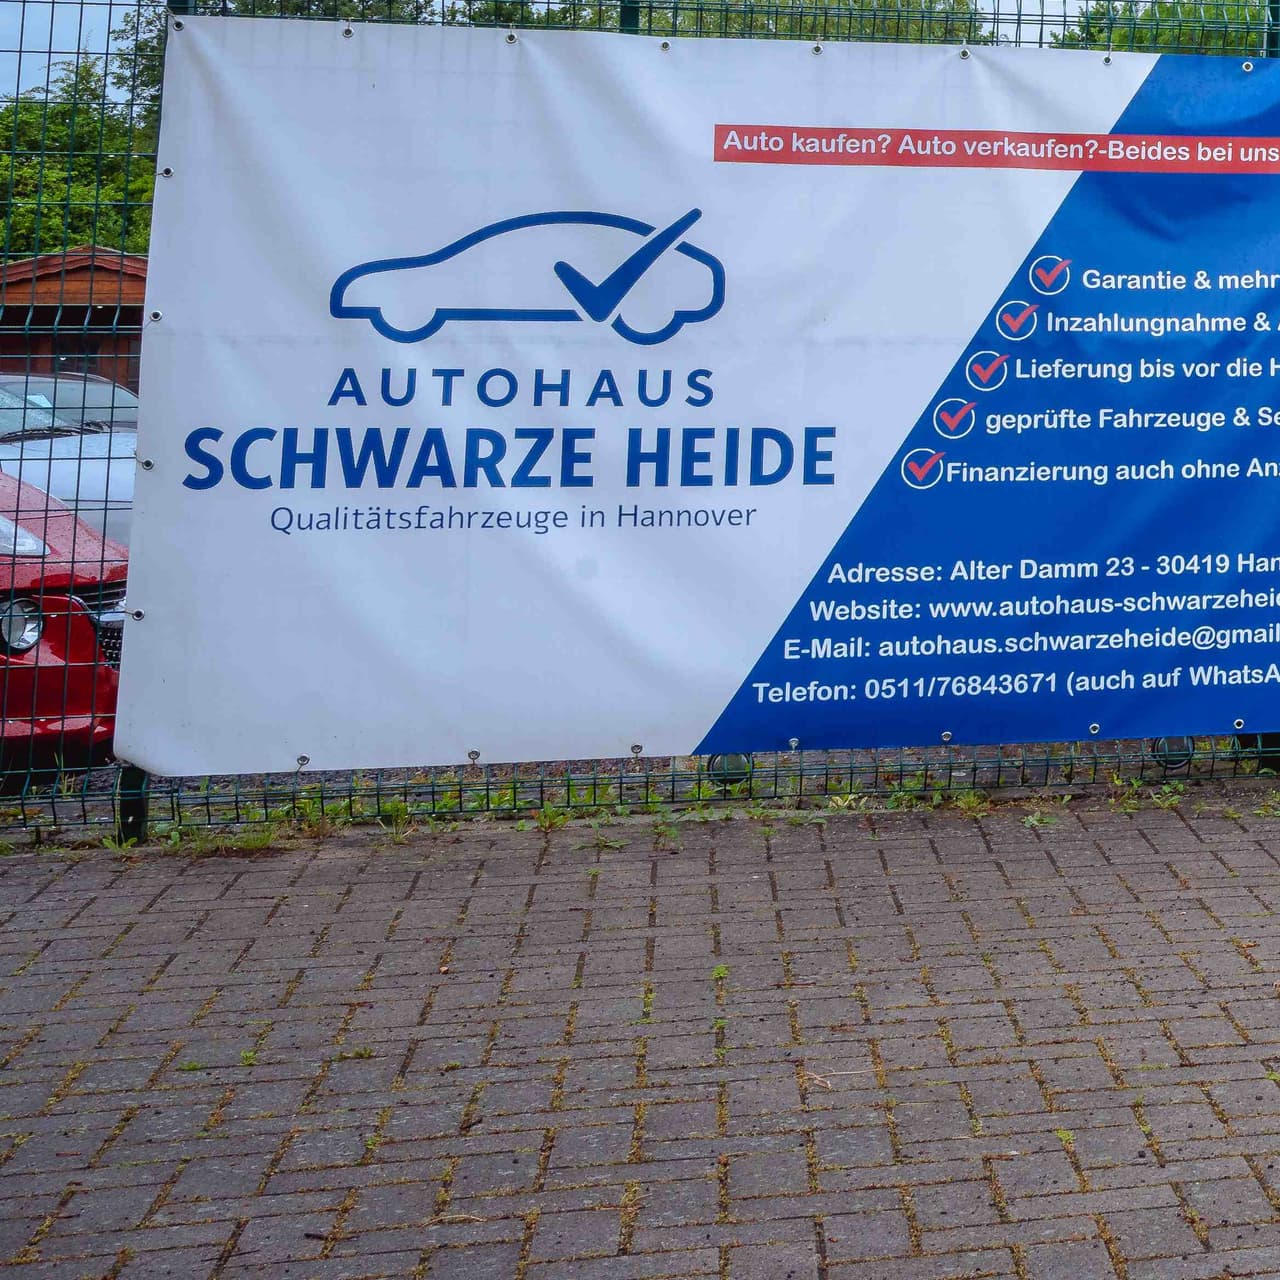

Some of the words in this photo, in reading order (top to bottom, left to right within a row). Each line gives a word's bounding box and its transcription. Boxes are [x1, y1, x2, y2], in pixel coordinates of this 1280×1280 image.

[723, 130, 784, 152] Auto
[791, 132, 892, 154] kaufen?
[897, 134, 957, 156] Auto
[963, 136, 1190, 161] verkaufen?-Beides
[1197, 141, 1233, 162] bei
[1082, 269, 1187, 290] Garantie
[1193, 270, 1212, 290] &
[1218, 269, 1280, 290] mehr
[1047, 312, 1247, 337] Inzahlungnahme
[1253, 311, 1272, 332] &
[1015, 358, 1133, 383] Lieferung
[1140, 358, 1175, 378] bis
[1181, 362, 1221, 378] vor
[1226, 357, 1263, 378] die
[327, 367, 714, 408] AUTOHAUS
[985, 408, 1092, 435] geprüfte
[1099, 408, 1226, 432] Fahrzeuge
[1232, 406, 1251, 427] &
[182, 426, 596, 491] SCHWARZE
[626, 426, 837, 488] HEIDE
[946, 461, 1108, 486] Finanzierung
[1115, 459, 1174, 480] auch
[1181, 458, 1240, 479] ohne
[270, 505, 569, 536] Qualitätsfahrzeuge
[581, 504, 605, 528] in
[617, 504, 757, 528] Hannover
[827, 562, 943, 584] Adresse:
[949, 560, 1013, 581] Alter
[1020, 559, 1099, 579] Damm
[1105, 556, 1135, 577] 23
[1156, 553, 1230, 575] 30419
[809, 599, 921, 622] Website:
[784, 636, 871, 660] E-Mail:
[752, 680, 857, 703] Telefon:
[864, 672, 1056, 700] 0511/76843671
[1066, 669, 1135, 697] (auch
[1142, 666, 1183, 689] auf
